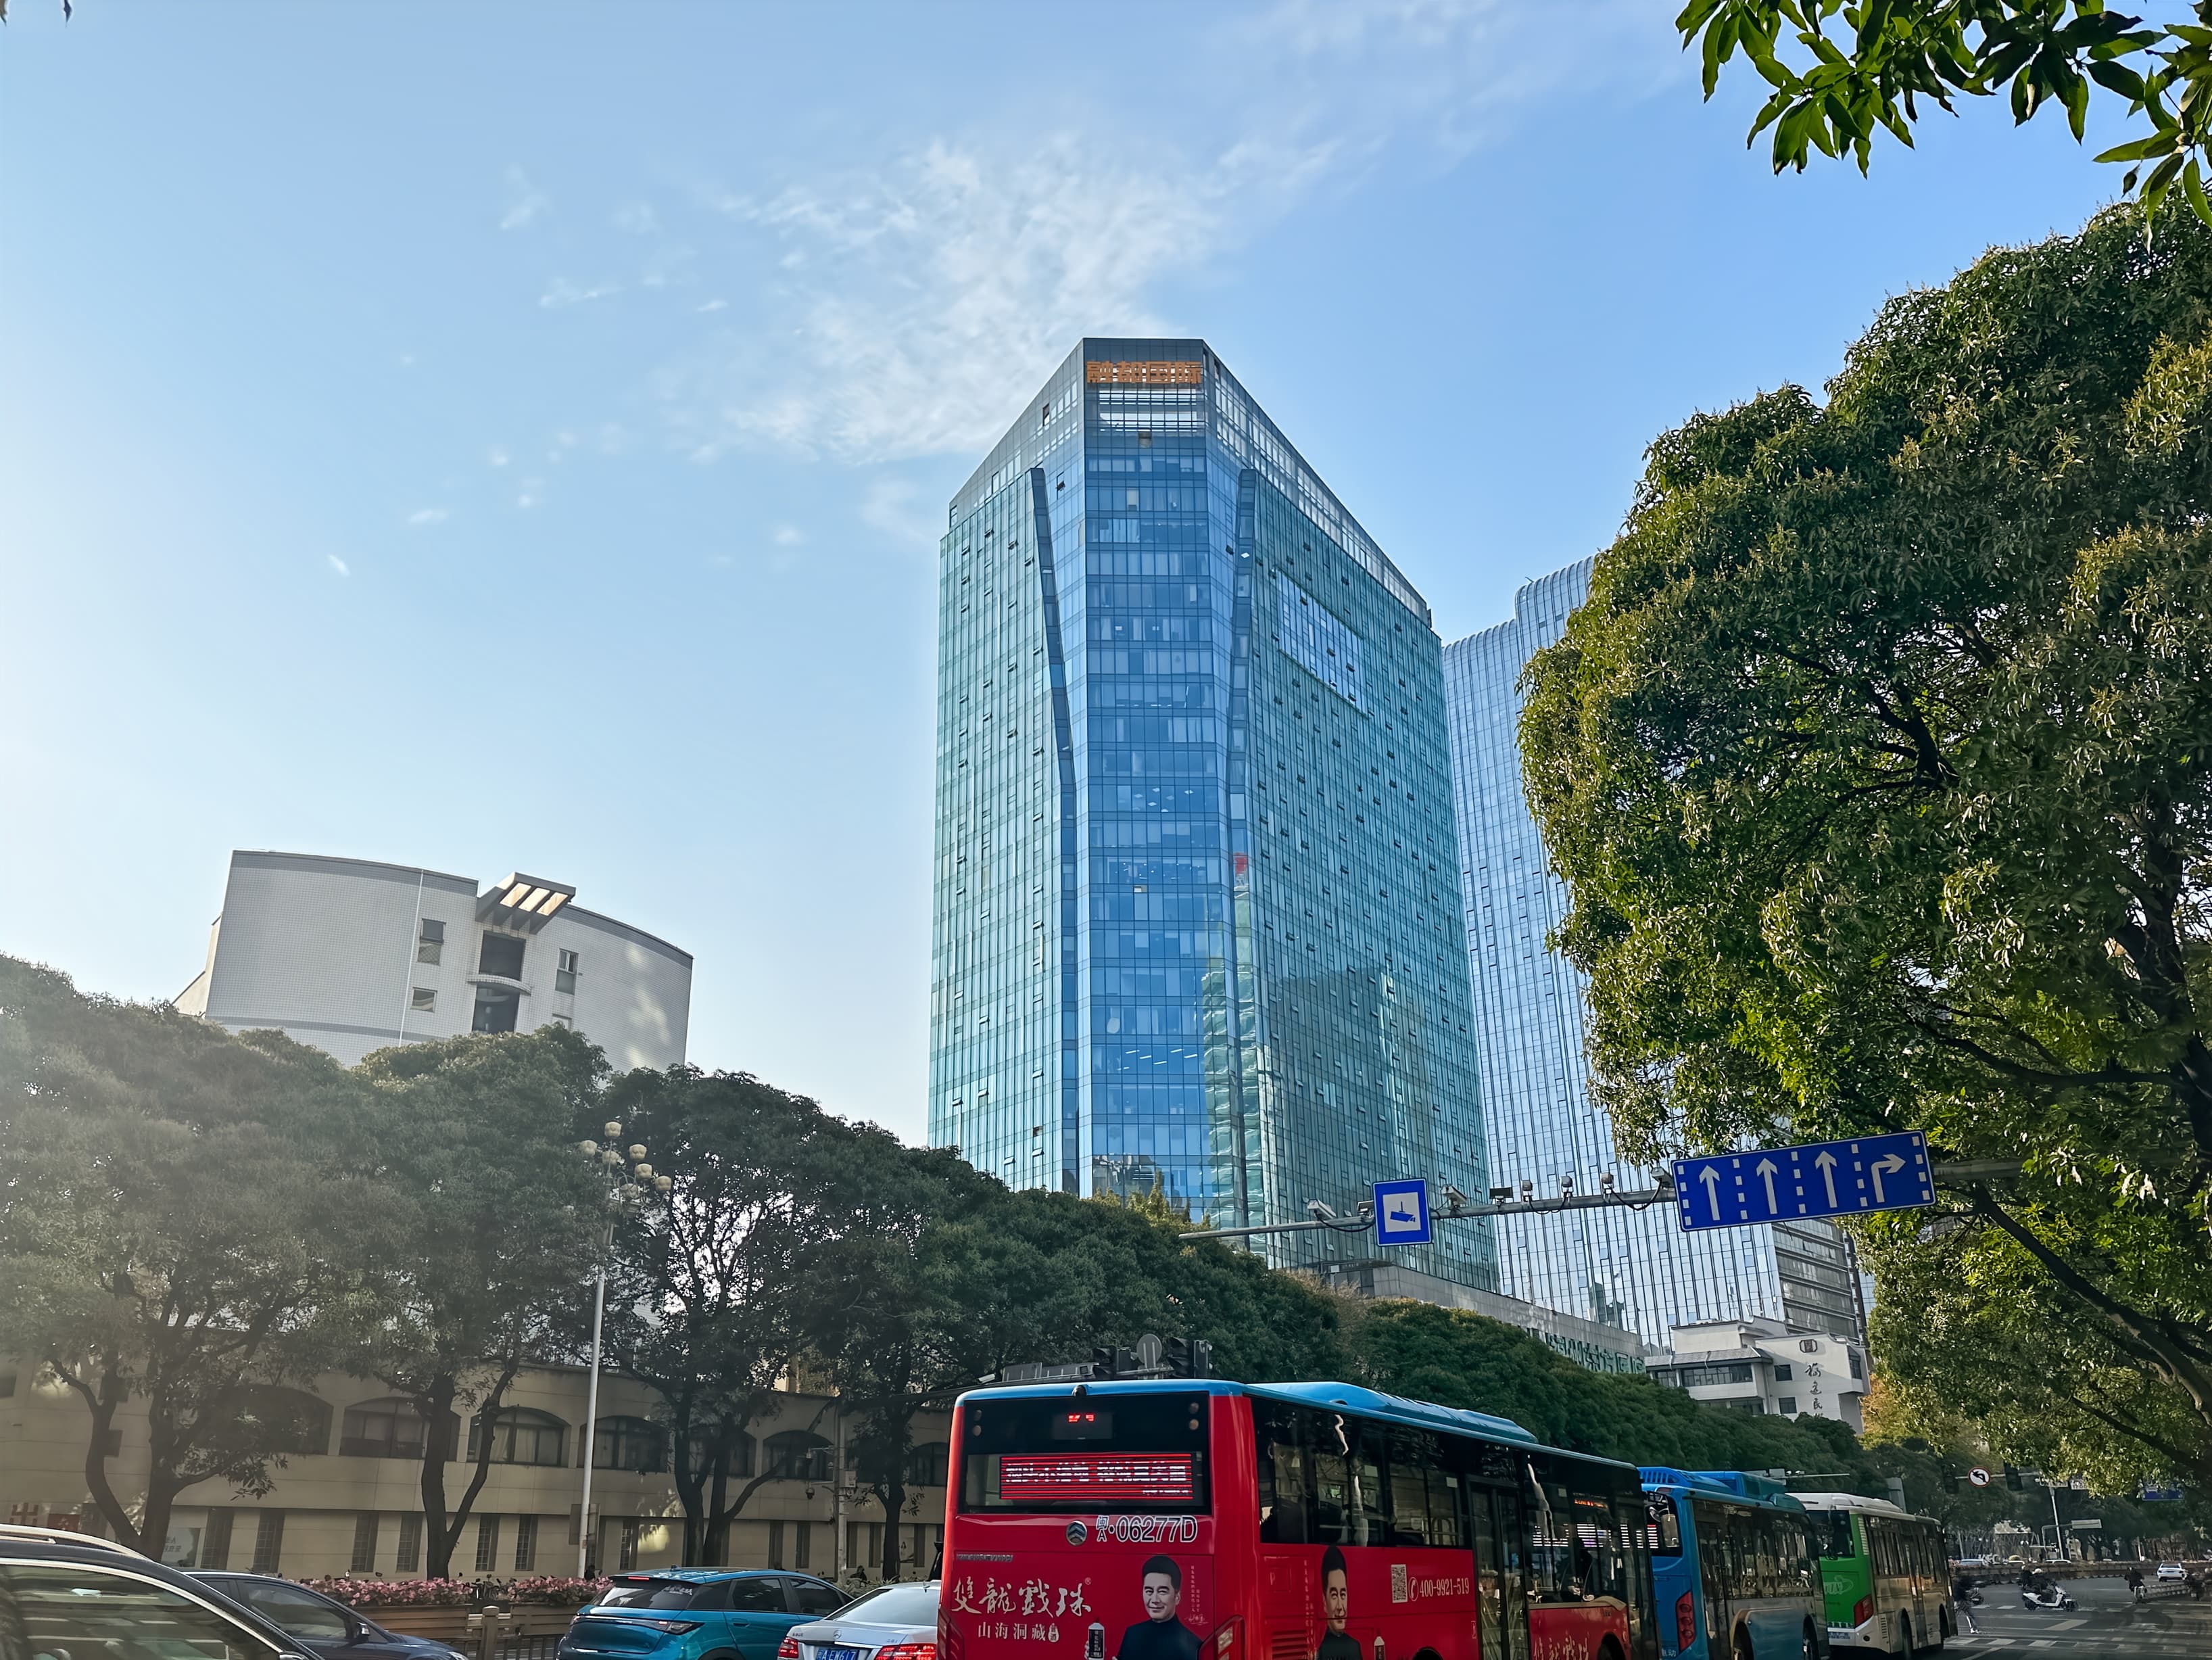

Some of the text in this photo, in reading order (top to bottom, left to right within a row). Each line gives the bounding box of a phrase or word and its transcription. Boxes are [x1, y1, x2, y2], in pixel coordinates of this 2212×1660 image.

[1419, 1578, 1470, 1598] 400-9921-519
[978, 1621, 1046, 1641] 山海洞藏
